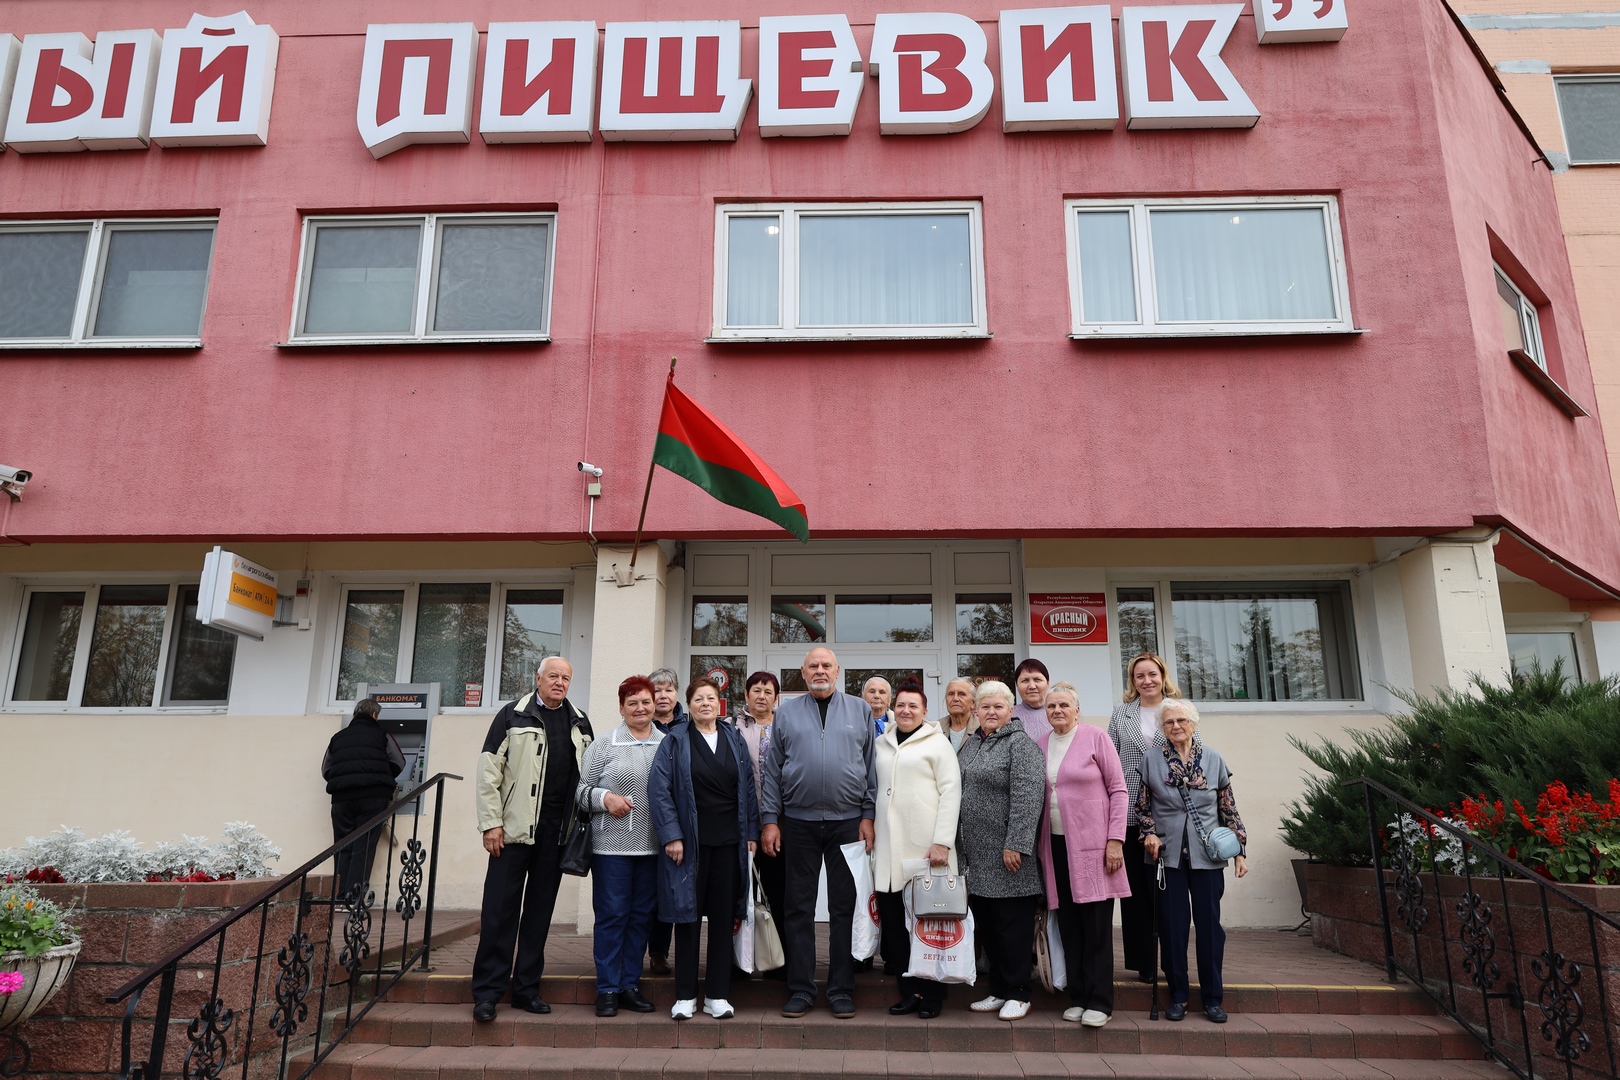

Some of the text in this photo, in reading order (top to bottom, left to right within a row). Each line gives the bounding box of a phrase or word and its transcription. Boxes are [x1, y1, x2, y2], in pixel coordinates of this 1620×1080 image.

[18, 20, 256, 130] ЫЙ
[233, 583, 253, 598] Банкомат
[1050, 612, 1088, 626] КРАСНЫЙ
